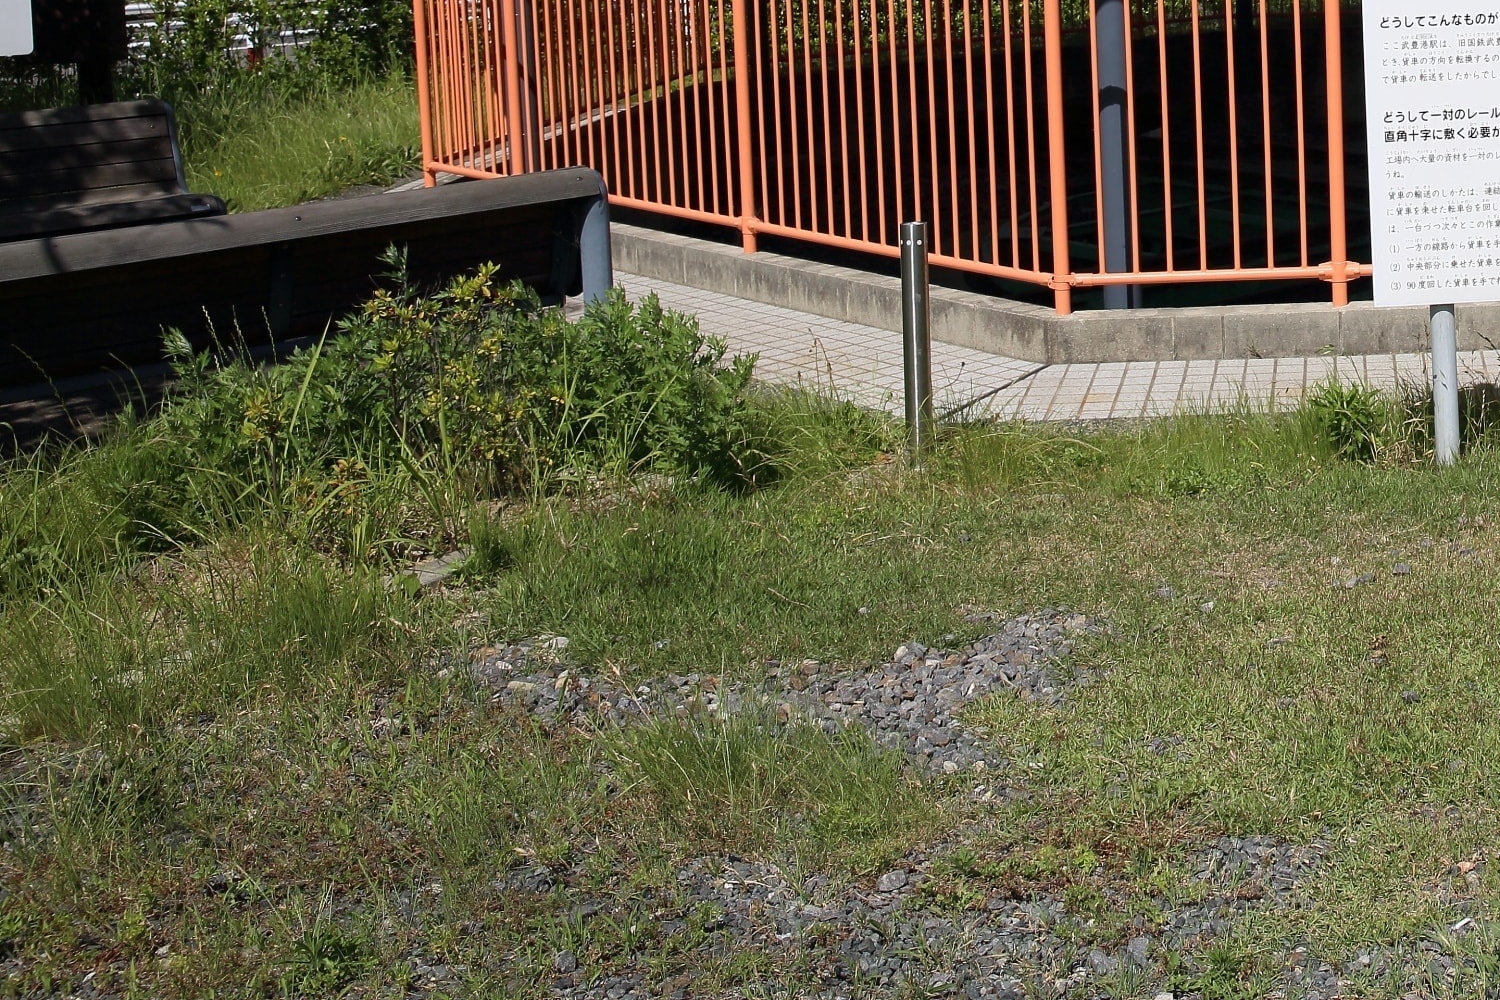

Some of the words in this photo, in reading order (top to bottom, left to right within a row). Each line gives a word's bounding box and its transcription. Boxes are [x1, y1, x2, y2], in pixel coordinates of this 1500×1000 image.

[1389, 244, 1400, 254] (1)
[1390, 263, 1400, 272] (2)
[1391, 281, 1401, 290] (3)
